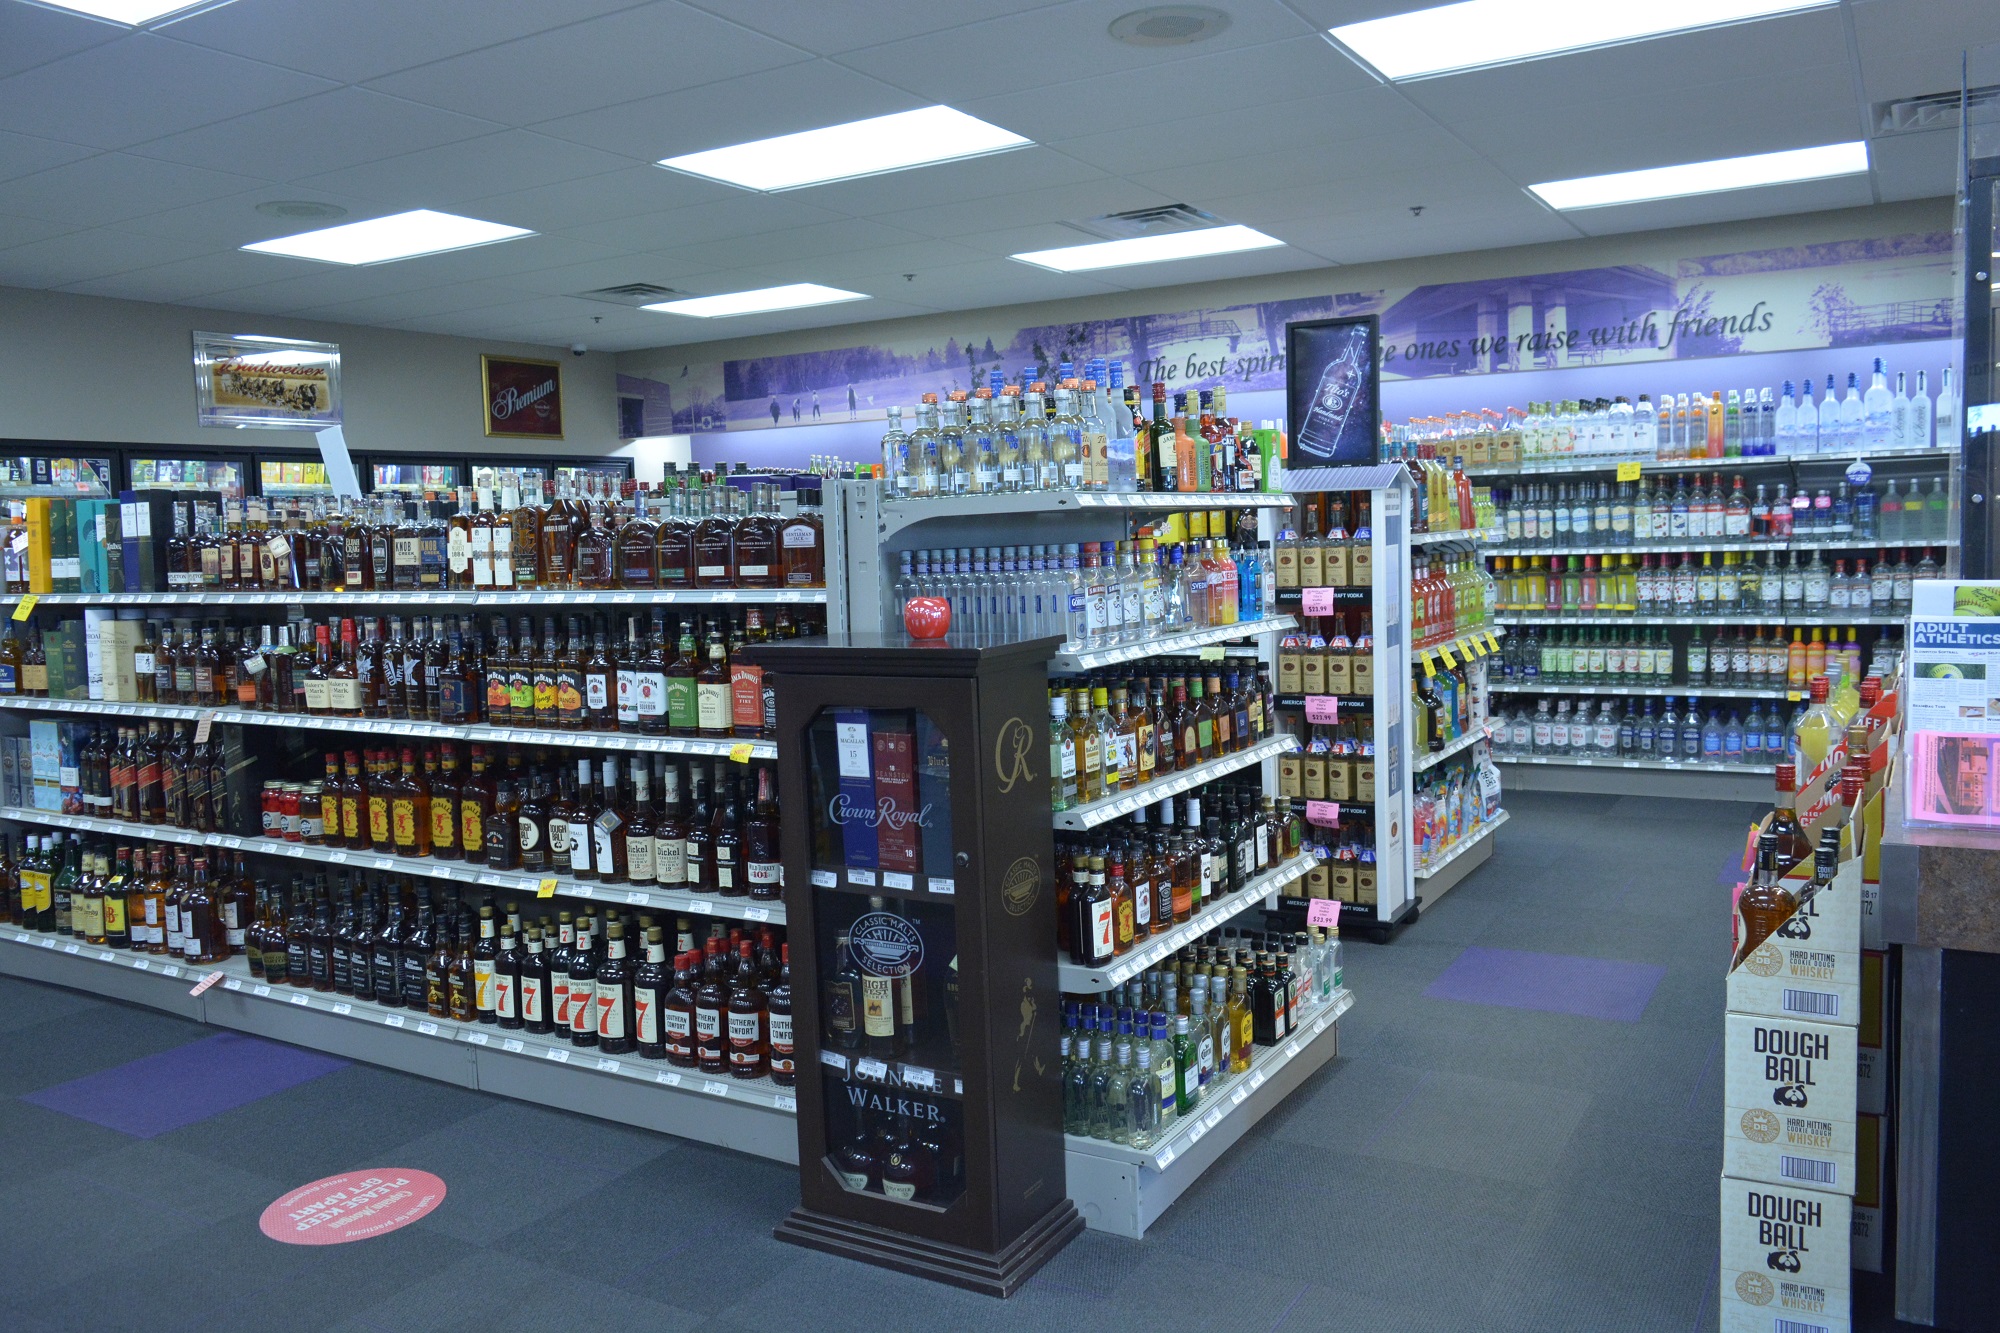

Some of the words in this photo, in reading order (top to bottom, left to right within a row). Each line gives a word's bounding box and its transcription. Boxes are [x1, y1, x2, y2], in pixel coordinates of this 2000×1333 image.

[1404, 339, 1460, 361] ones
[1467, 335, 1507, 355] we
[1515, 323, 1580, 353] raise
[1587, 312, 1657, 345] with
[1658, 301, 1773, 350] friends
[214, 355, 325, 377] Budweiser
[1138, 359, 1177, 382] The
[1185, 353, 1227, 378] best
[1234, 347, 1286, 383] spiri
[1324, 383, 1350, 398] Tito's
[491, 378, 556, 420] Premium
[1308, 605, 1328, 613] $23.99
[1915, 622, 1969, 633] ADULT
[1915, 633, 2000, 645] ATHLETICS
[849, 750, 857, 758] 15
[829, 793, 876, 825] Crown
[865, 796, 933, 831] Royal
[657, 847, 680, 856] Dickel
[905, 849, 913, 857] 18
[855, 916, 888, 935] CLASSIC
[890, 919, 917, 942] MALTS
[1099, 911, 1111, 945] 7
[1756, 957, 1770, 965] DB
[1790, 950, 1808, 960] HARD
[1810, 952, 1835, 962] HITTING
[1790, 958, 1811, 966] COOKIE
[1814, 960, 1835, 968] DOUGH
[862, 955, 911, 974] SELECTION
[1790, 965, 1835, 980] WHISKEY
[474, 973, 491, 1007] 7
[496, 983, 508, 1012] 7
[523, 987, 536, 1015] 7
[570, 992, 592, 1029] 7
[598, 997, 616, 1034] 7
[636, 1001, 649, 1039] 7
[666, 1014, 687, 1024] SOUTHERN
[667, 1021, 685, 1030] COMFORT
[697, 1014, 716, 1023] UTHERN
[728, 1018, 756, 1026] SOUTHERN
[771, 1020, 793, 1029] SOUTH
[730, 1026, 754, 1035] COMFORT
[772, 1030, 793, 1039] COMFO
[1754, 1027, 1829, 1060] DOUGH
[1765, 1055, 1816, 1086] BALL
[846, 1085, 940, 1122] WALKER
[1753, 1123, 1768, 1131] DB
[1786, 1117, 1805, 1128] HARD
[1807, 1120, 1832, 1131] HITTING
[1787, 1125, 1808, 1134] COOKIE
[1811, 1128, 1832, 1137] DOUGH
[1787, 1132, 1832, 1148] WHISKEY
[340, 1177, 411, 1210] PLEASE
[288, 1191, 348, 1221] APART
[1748, 1191, 1822, 1228] DOUGH
[295, 1207, 345, 1231] KEEP
[1759, 1219, 1809, 1252] BALL
[1747, 1285, 1762, 1294] DB
[1780, 1282, 1799, 1293] HARD
[1800, 1285, 1825, 1297] HITTING
[1780, 1290, 1802, 1299] COOKIE
[1804, 1293, 1825, 1302] DOUGH
[1781, 1296, 1825, 1313] WHISKEY
